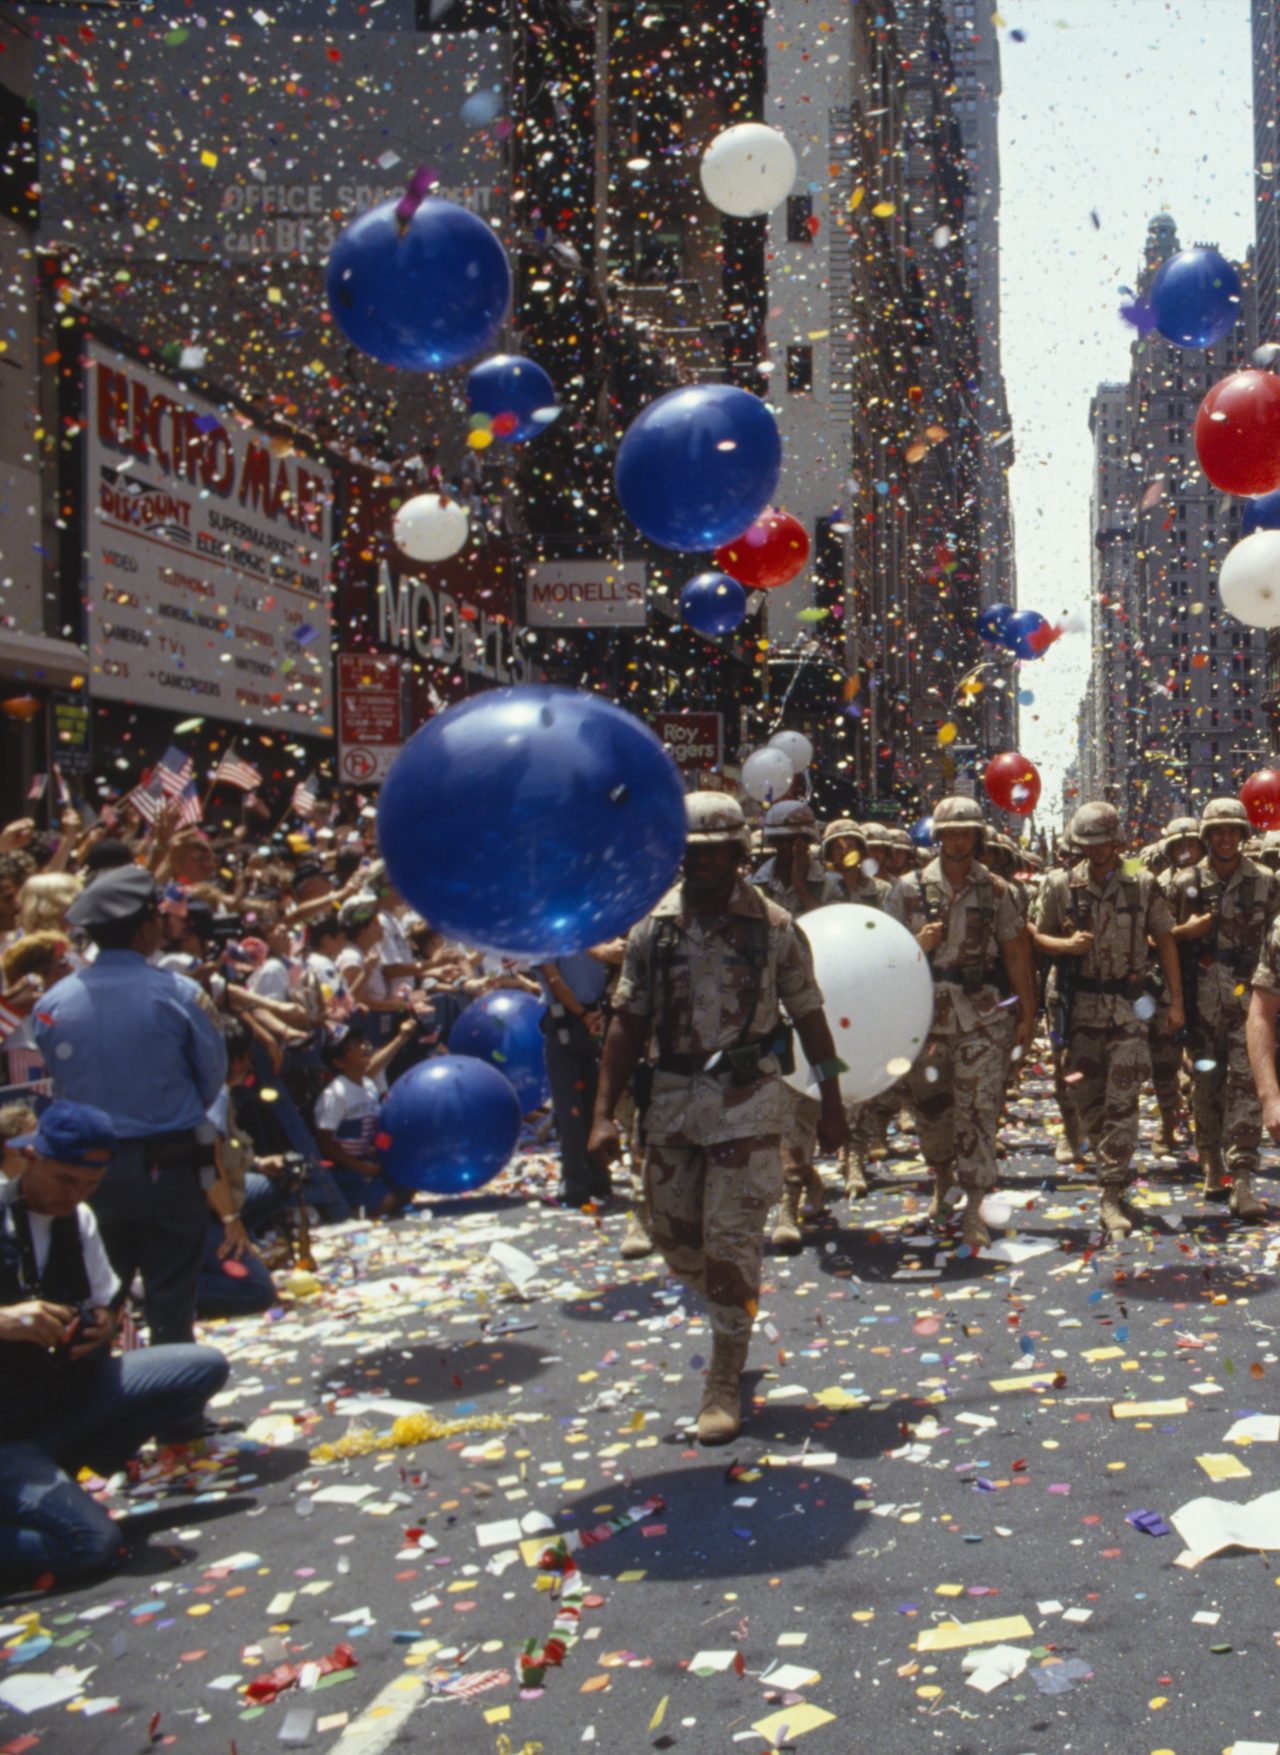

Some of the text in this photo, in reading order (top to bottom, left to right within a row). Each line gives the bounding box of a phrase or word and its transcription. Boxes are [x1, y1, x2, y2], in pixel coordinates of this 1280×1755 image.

[226, 184, 322, 213] OFFICE
[224, 233, 267, 252] CALL
[97, 362, 235, 499] ELECTRO
[100, 478, 191, 527] DISCOUNT
[208, 509, 296, 558] SUPERMARKET
[196, 532, 266, 573] ELECTRONIC
[532, 582, 642, 602] MODELL'S
[158, 670, 221, 697] CAMCORDERS
[664, 724, 699, 744] Roy
[668, 742, 714, 762] gers
